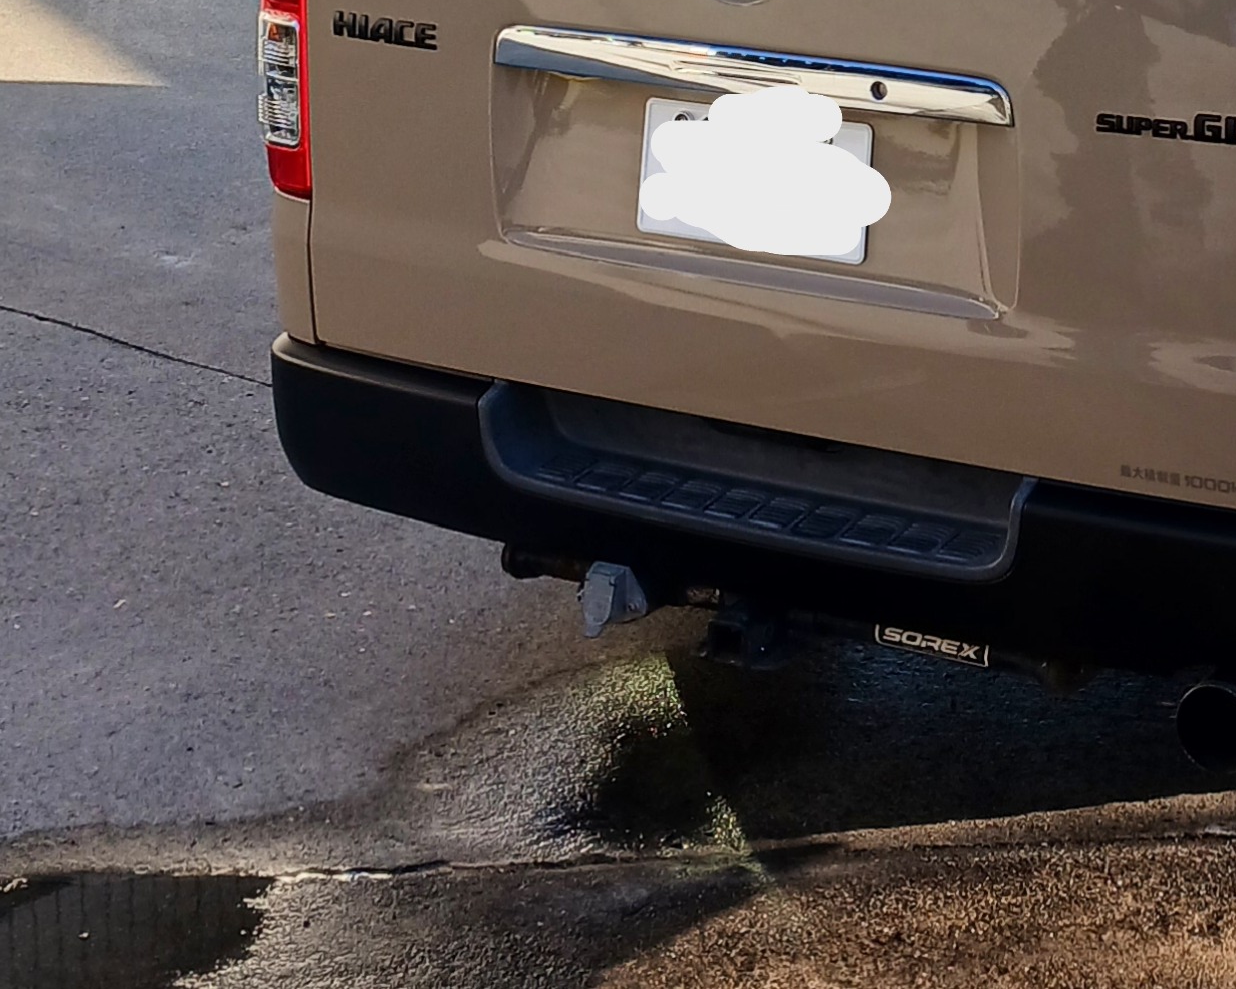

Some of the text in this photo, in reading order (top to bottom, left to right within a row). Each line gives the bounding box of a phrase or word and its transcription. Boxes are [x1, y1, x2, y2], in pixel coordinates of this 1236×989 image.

[333, 10, 438, 51] HIACE
[1095, 113, 1190, 140] SUPER
[882, 627, 981, 660] SOREX
